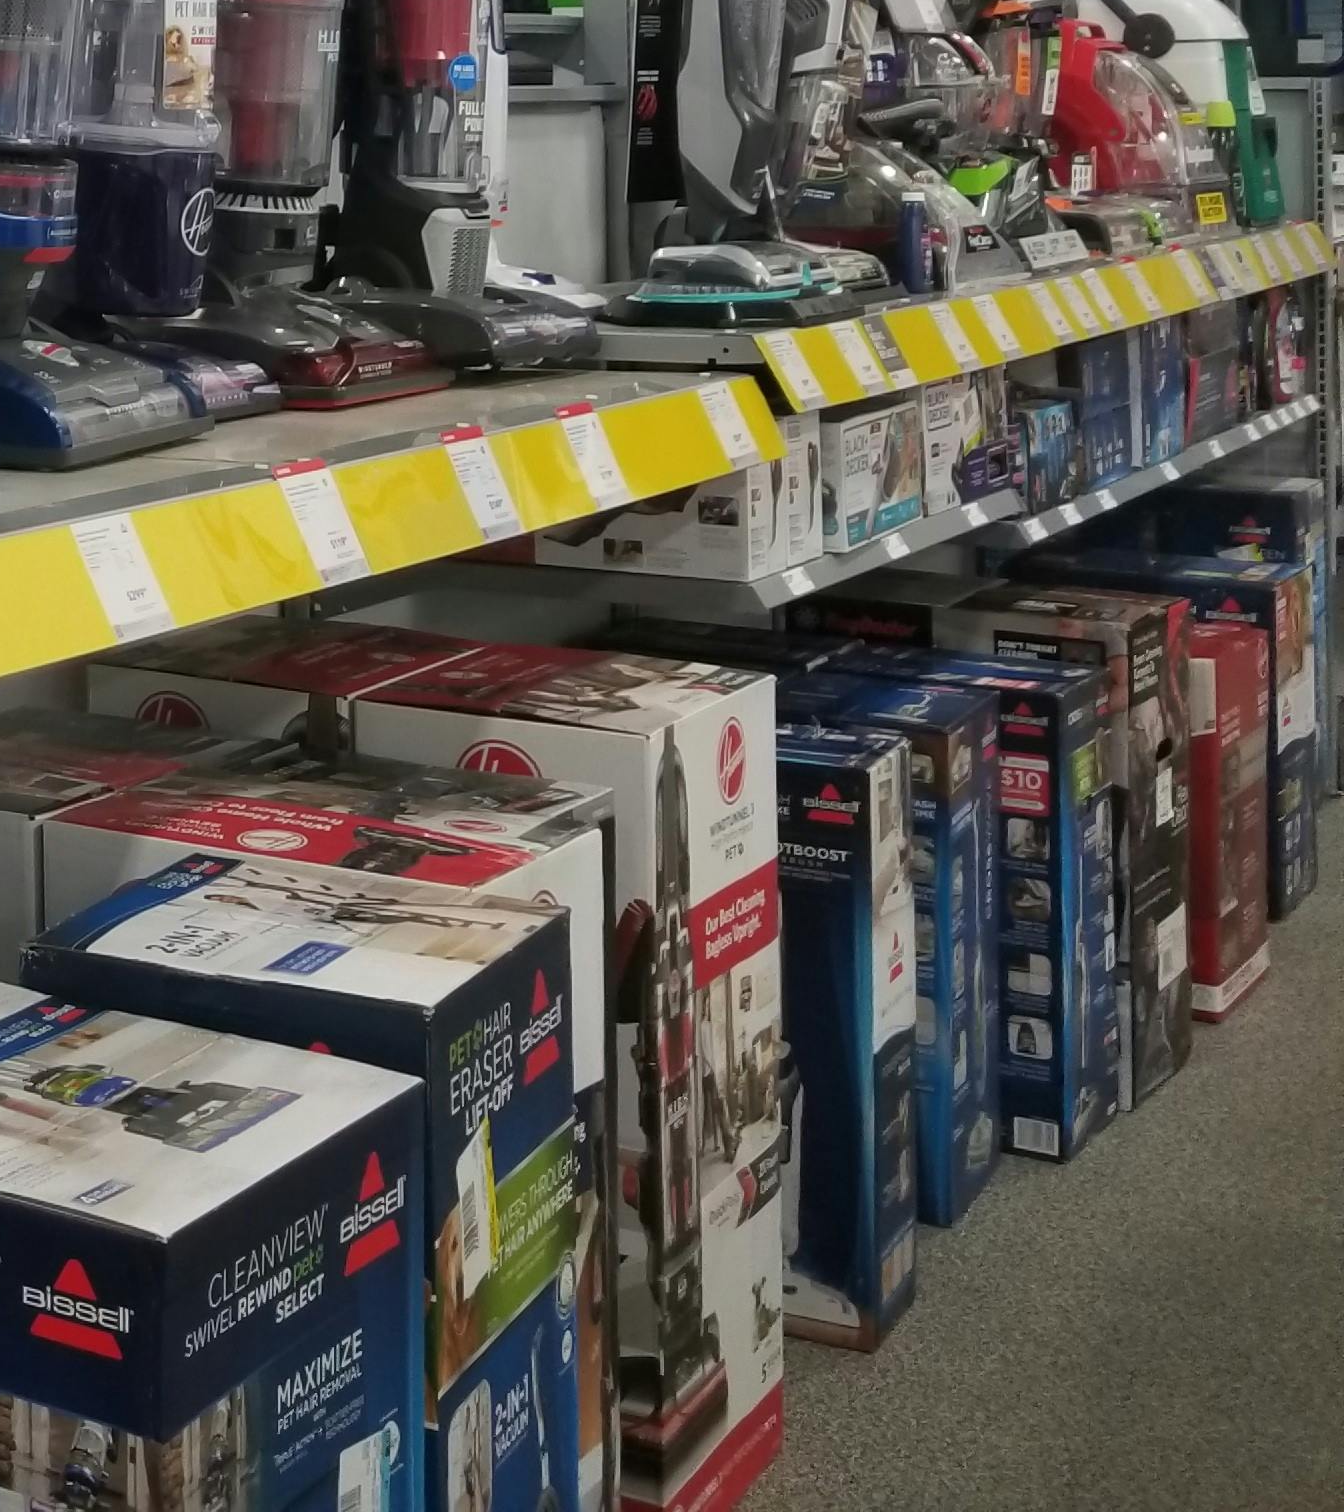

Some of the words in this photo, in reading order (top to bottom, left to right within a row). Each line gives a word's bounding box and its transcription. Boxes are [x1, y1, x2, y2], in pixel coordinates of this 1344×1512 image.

[1001, 768, 1042, 790] $10
[145, 922, 214, 954] 2-IN-1
[705, 916, 719, 936] Our
[719, 906, 735, 930] Best
[736, 889, 766, 920] Cleaning
[449, 1029, 471, 1072] PET
[483, 1001, 512, 1045] HAIR
[450, 1034, 513, 1117] ERASER
[465, 1073, 514, 1137] LIFT-OFF
[526, 1178, 574, 1240] ANYWHERE
[208, 1203, 328, 1309] CLEANVIEW
[183, 1306, 237, 1359] SWIVEL
[237, 1267, 292, 1321] REWIND
[293, 1253, 315, 1285] pet
[275, 1273, 325, 1324] SELECT
[277, 1328, 363, 1415] MAXIMIZE
[277, 1410, 294, 1435] PET
[295, 1395, 318, 1420] HAIR
[319, 1363, 363, 1403] REMOVAL
[495, 1372, 529, 1436] 2-IN-1
